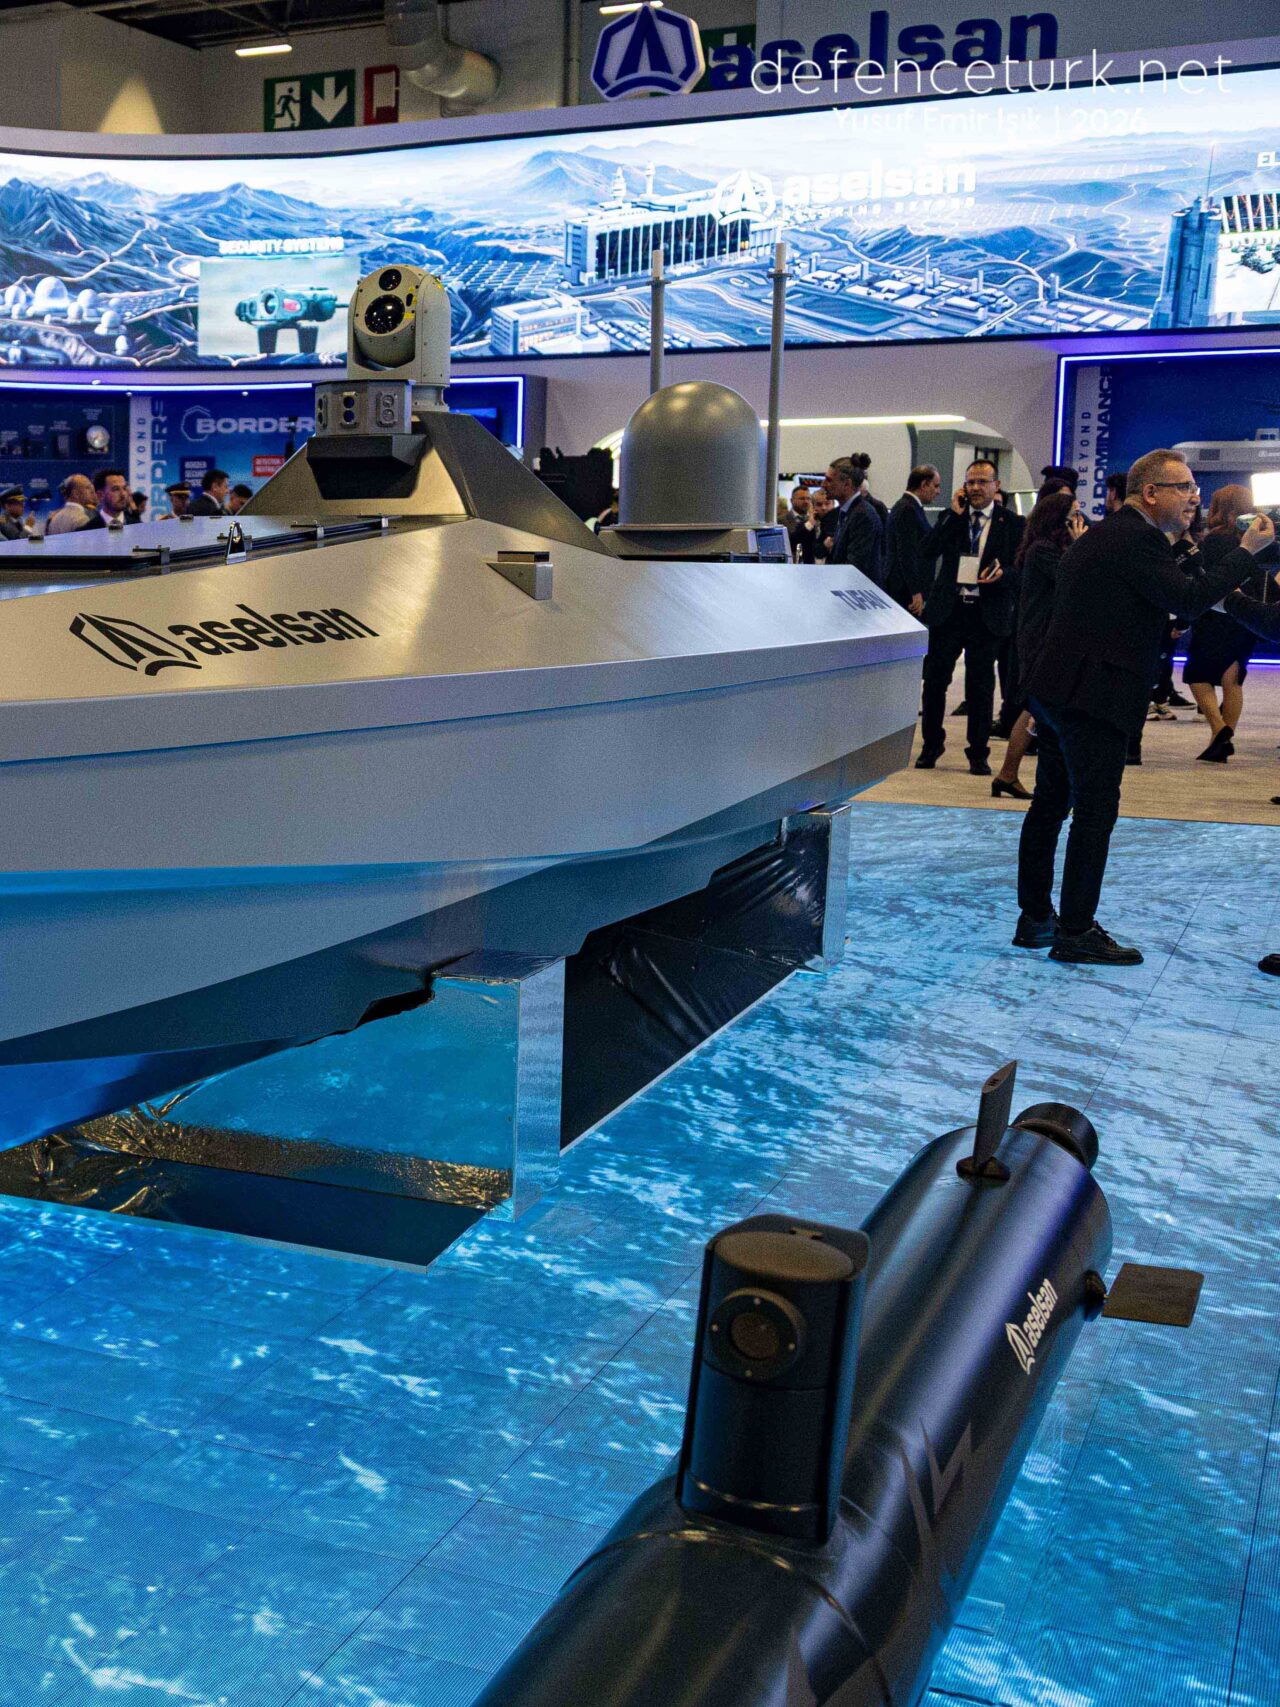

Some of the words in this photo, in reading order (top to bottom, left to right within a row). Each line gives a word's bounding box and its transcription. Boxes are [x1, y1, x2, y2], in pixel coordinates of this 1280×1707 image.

[709, 10, 1059, 90] aselsan
[782, 158, 976, 207] aselsan
[1077, 411, 1092, 486] BEYOND
[167, 603, 380, 656] aselsan
[830, 590, 892, 611] TUFAN
[1023, 1278, 1058, 1348] aselsan
